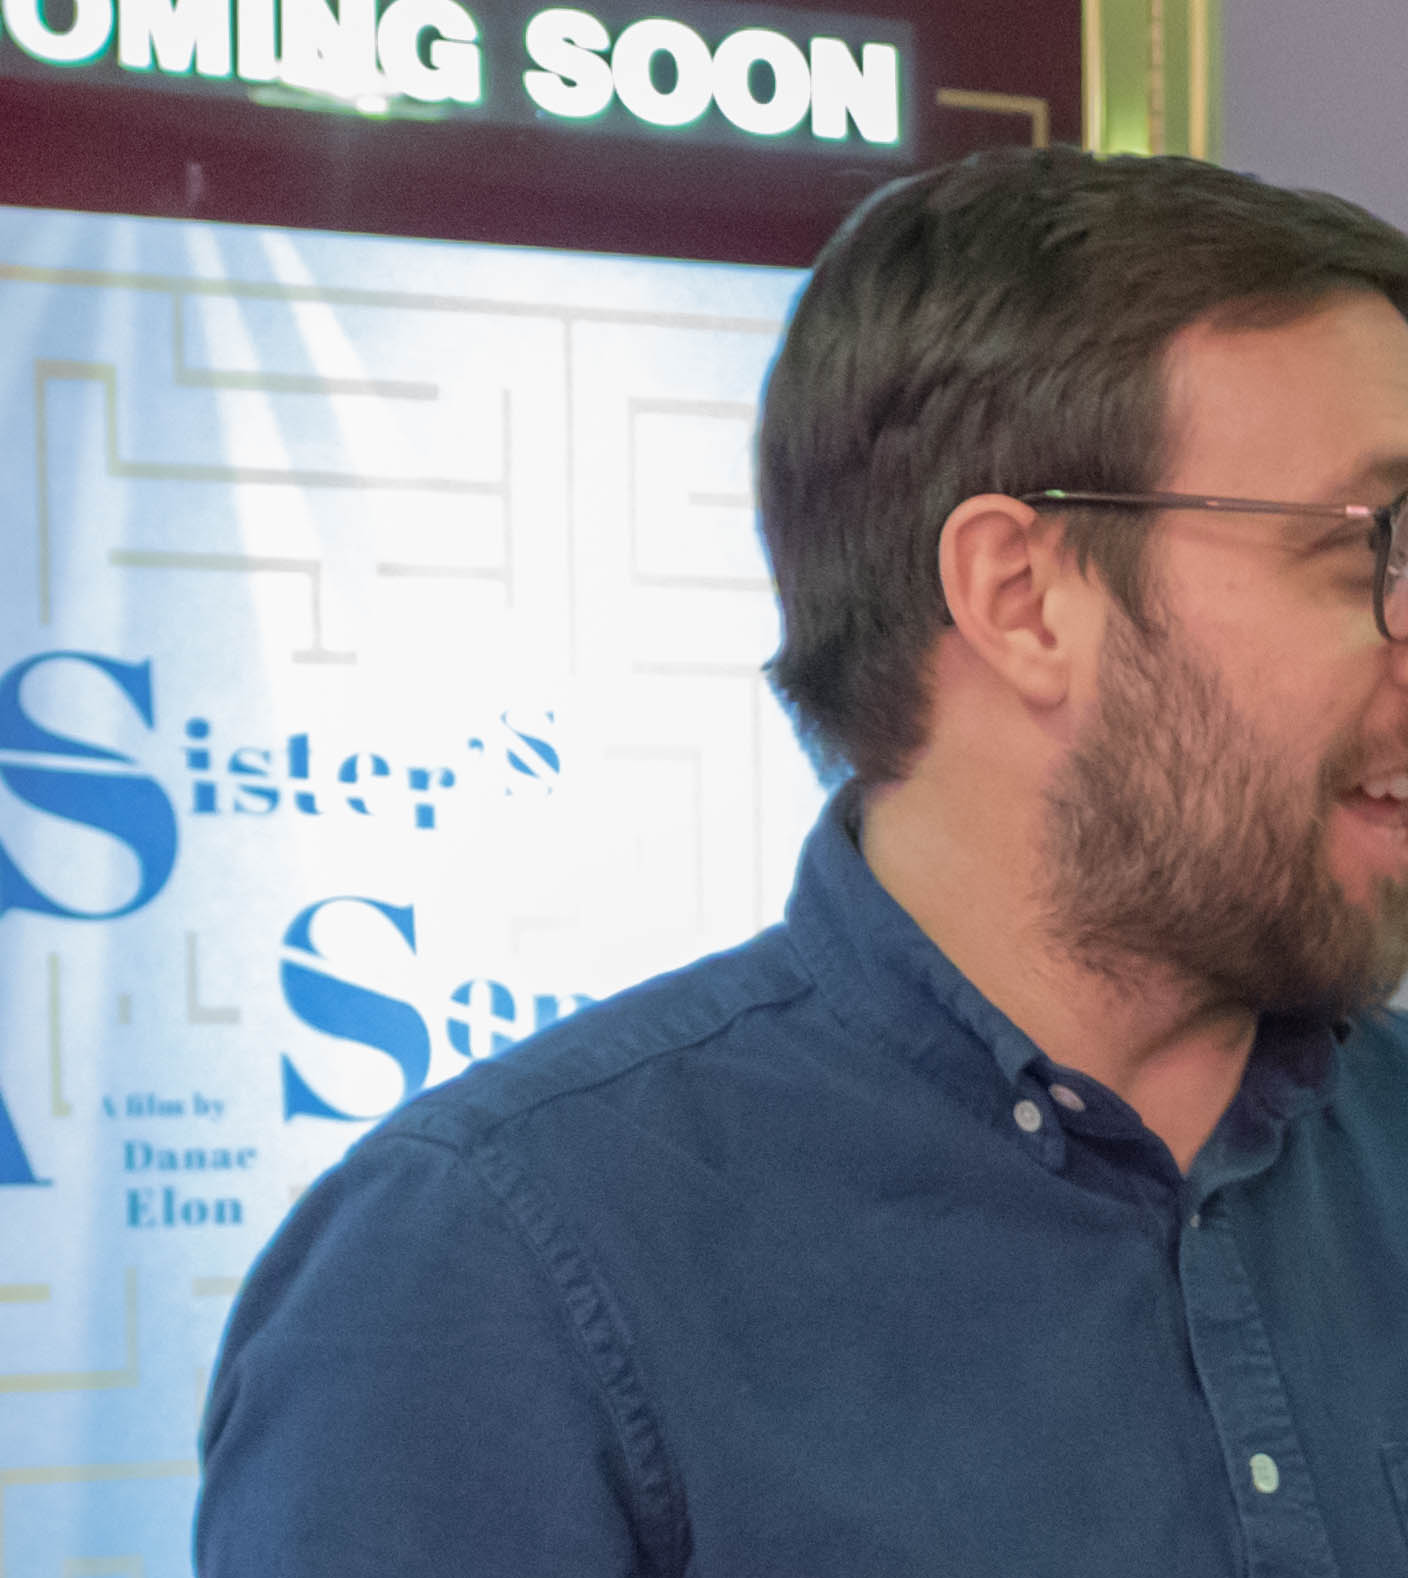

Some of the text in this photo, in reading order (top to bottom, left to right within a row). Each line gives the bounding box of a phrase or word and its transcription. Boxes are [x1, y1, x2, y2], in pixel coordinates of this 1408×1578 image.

[522, 8, 900, 145] SOON
[192, 1089, 225, 1125] by
[126, 1185, 243, 1228] Elon
